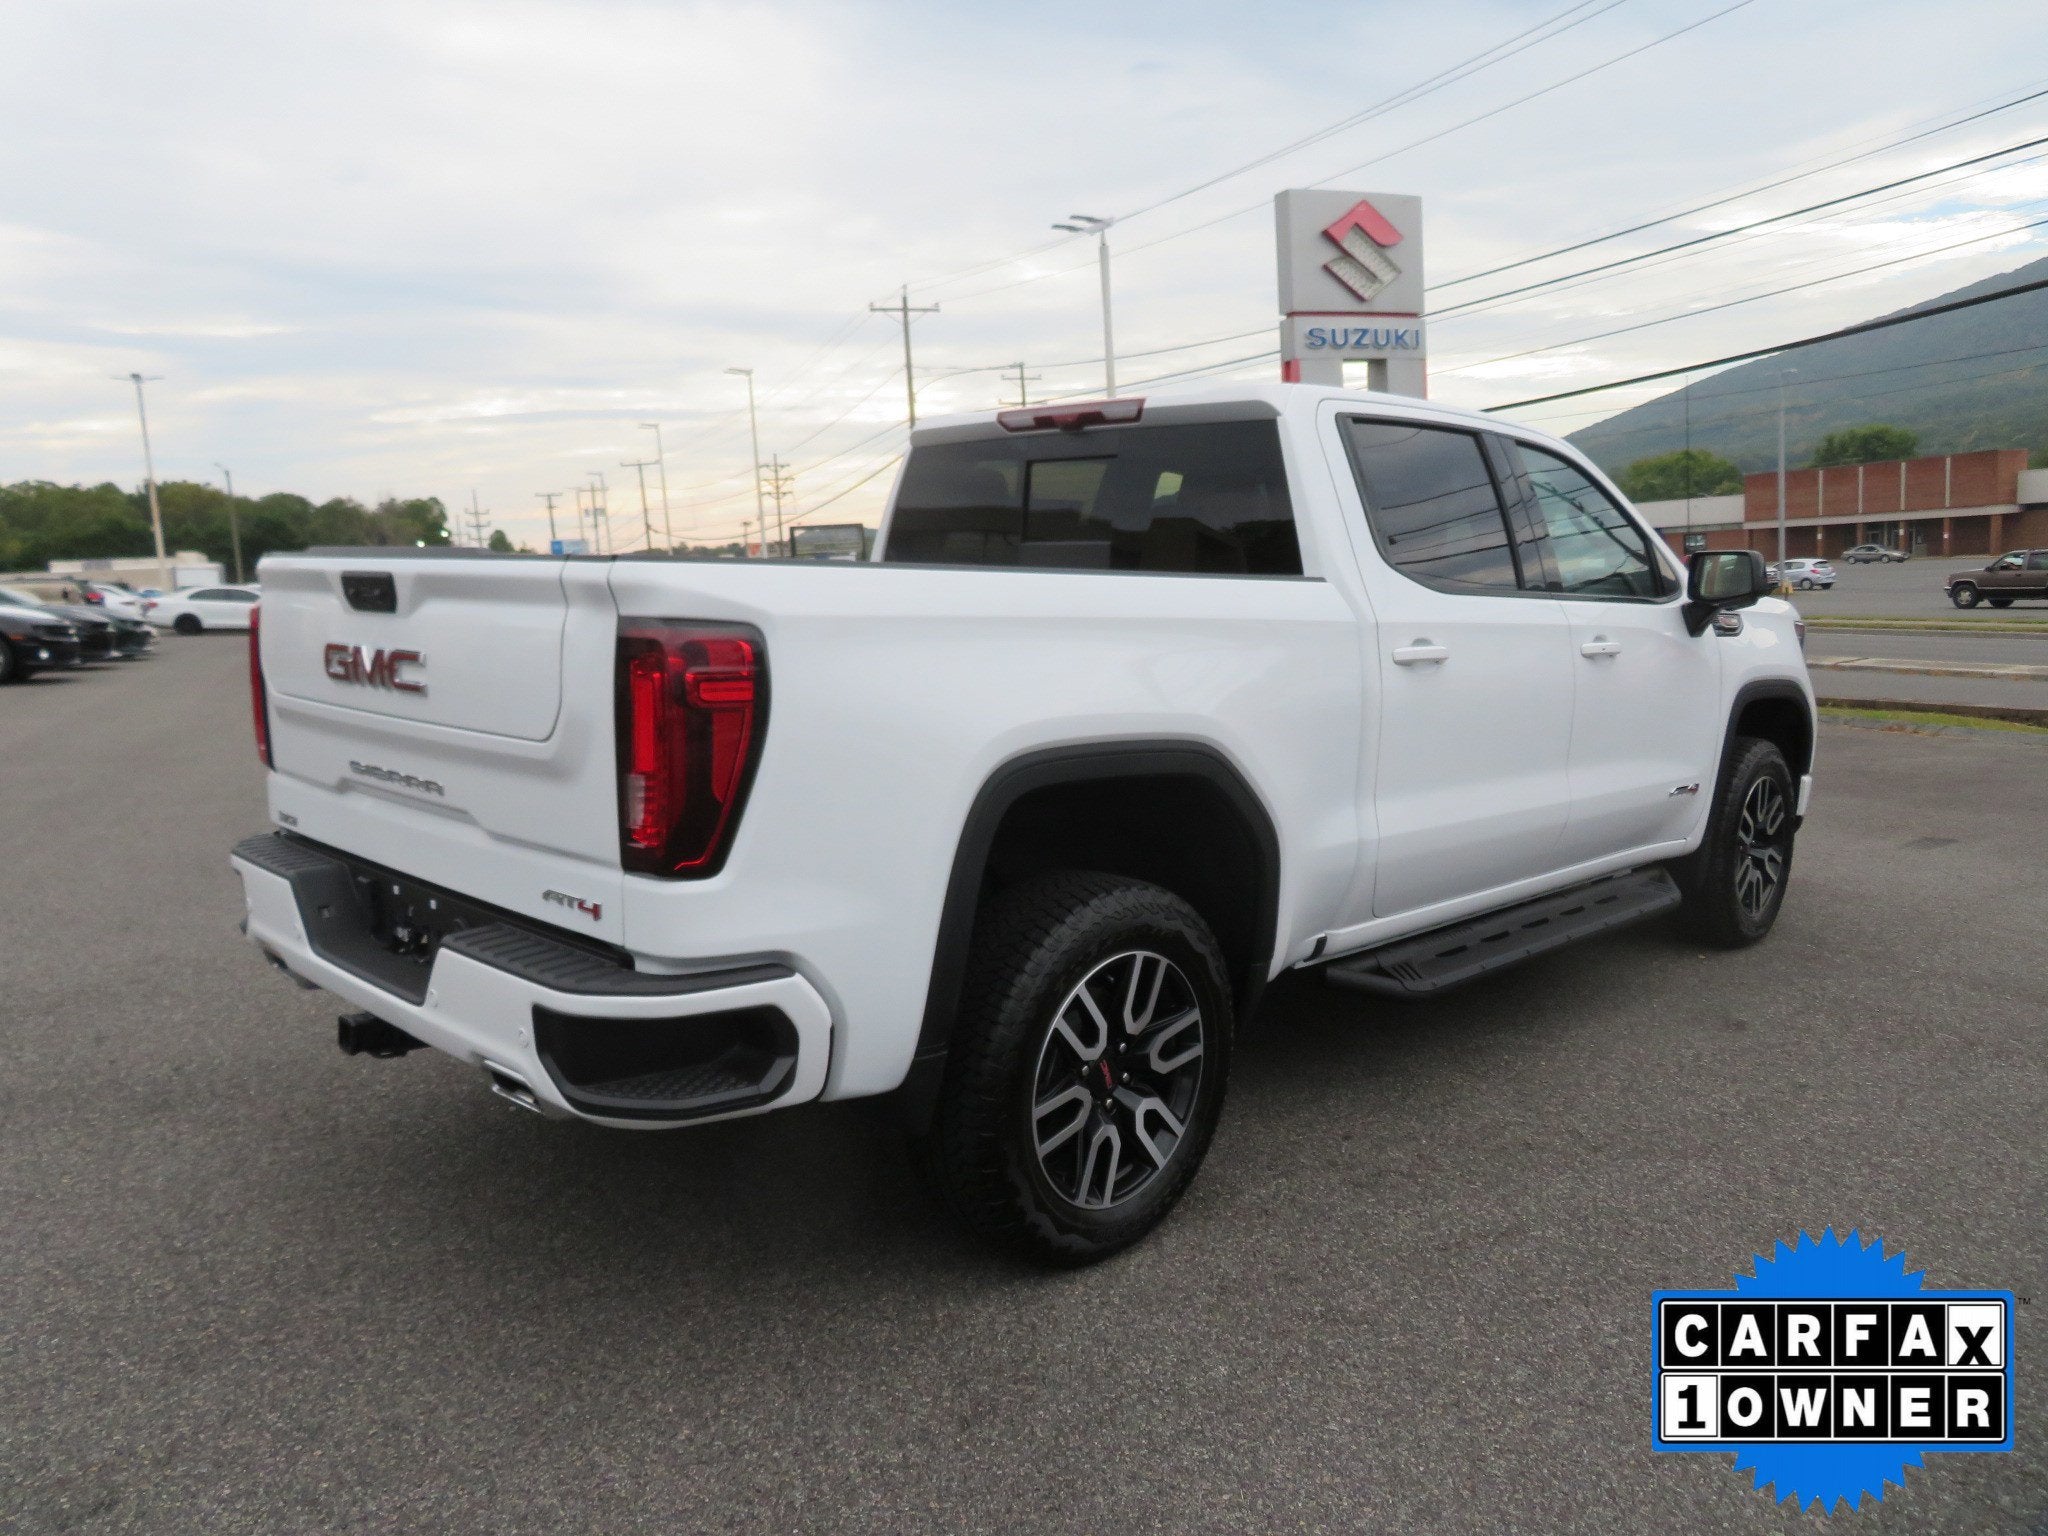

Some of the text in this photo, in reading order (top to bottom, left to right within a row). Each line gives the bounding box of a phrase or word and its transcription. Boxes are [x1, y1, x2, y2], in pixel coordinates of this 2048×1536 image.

[1307, 327, 1420, 350] SUZUKI
[324, 643, 428, 697] GMC
[542, 888, 603, 923] AT4
